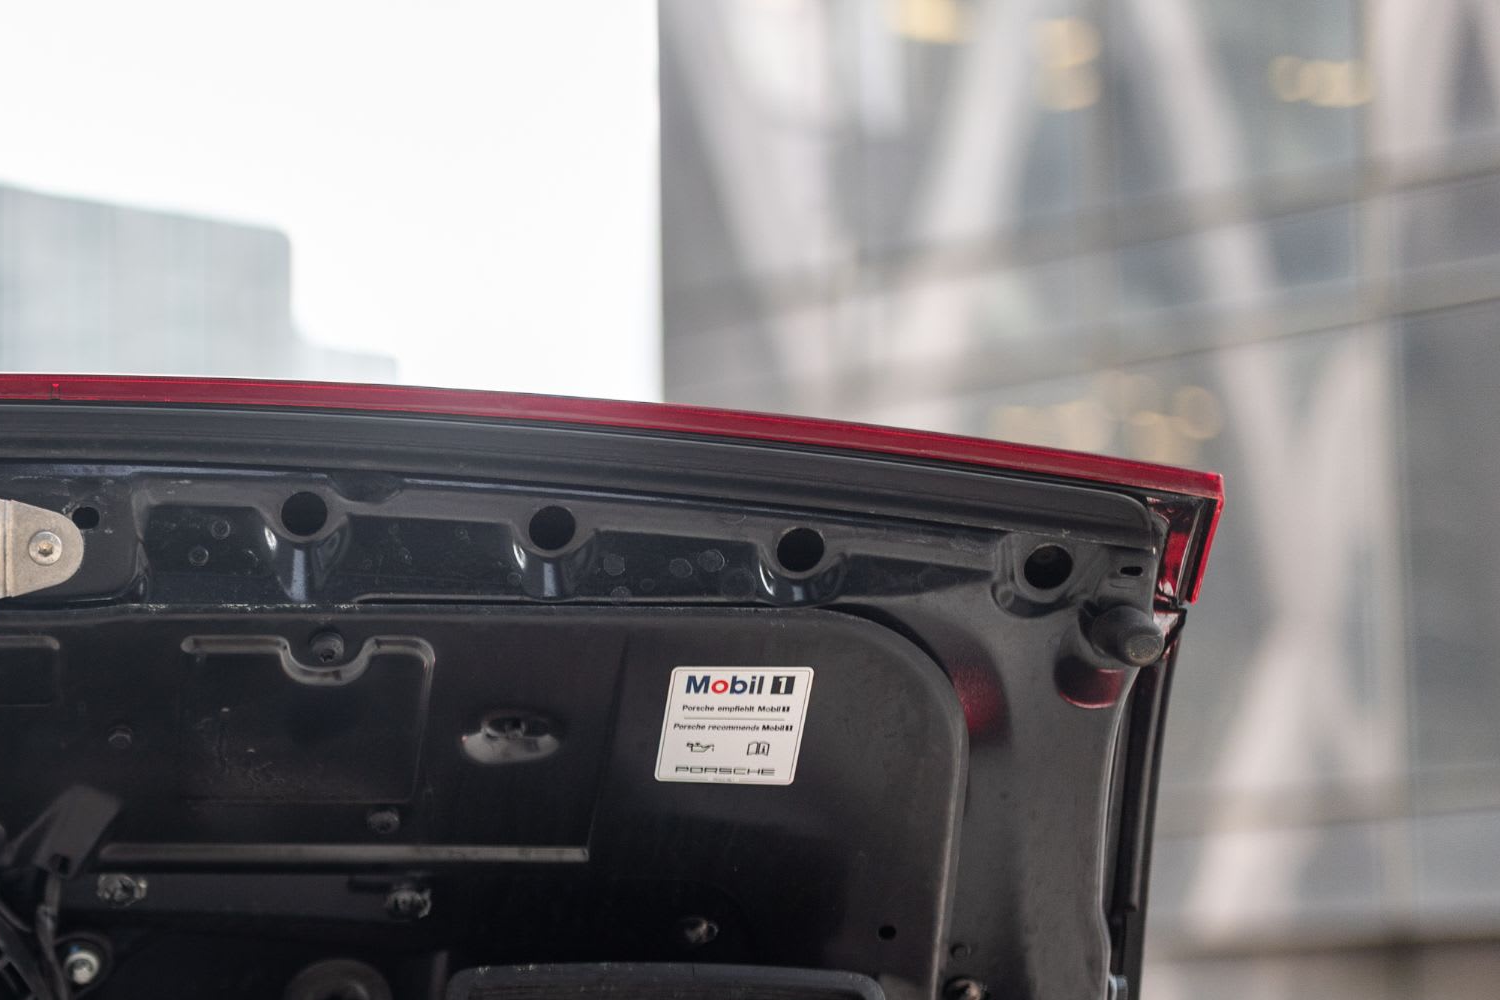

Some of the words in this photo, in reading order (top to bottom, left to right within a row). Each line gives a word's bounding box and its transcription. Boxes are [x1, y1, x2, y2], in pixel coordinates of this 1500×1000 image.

[685, 675, 764, 695] Mobil
[683, 704, 714, 712] Porsche
[717, 705, 754, 713] empfiehlt
[675, 766, 775, 776] PORSCHE
